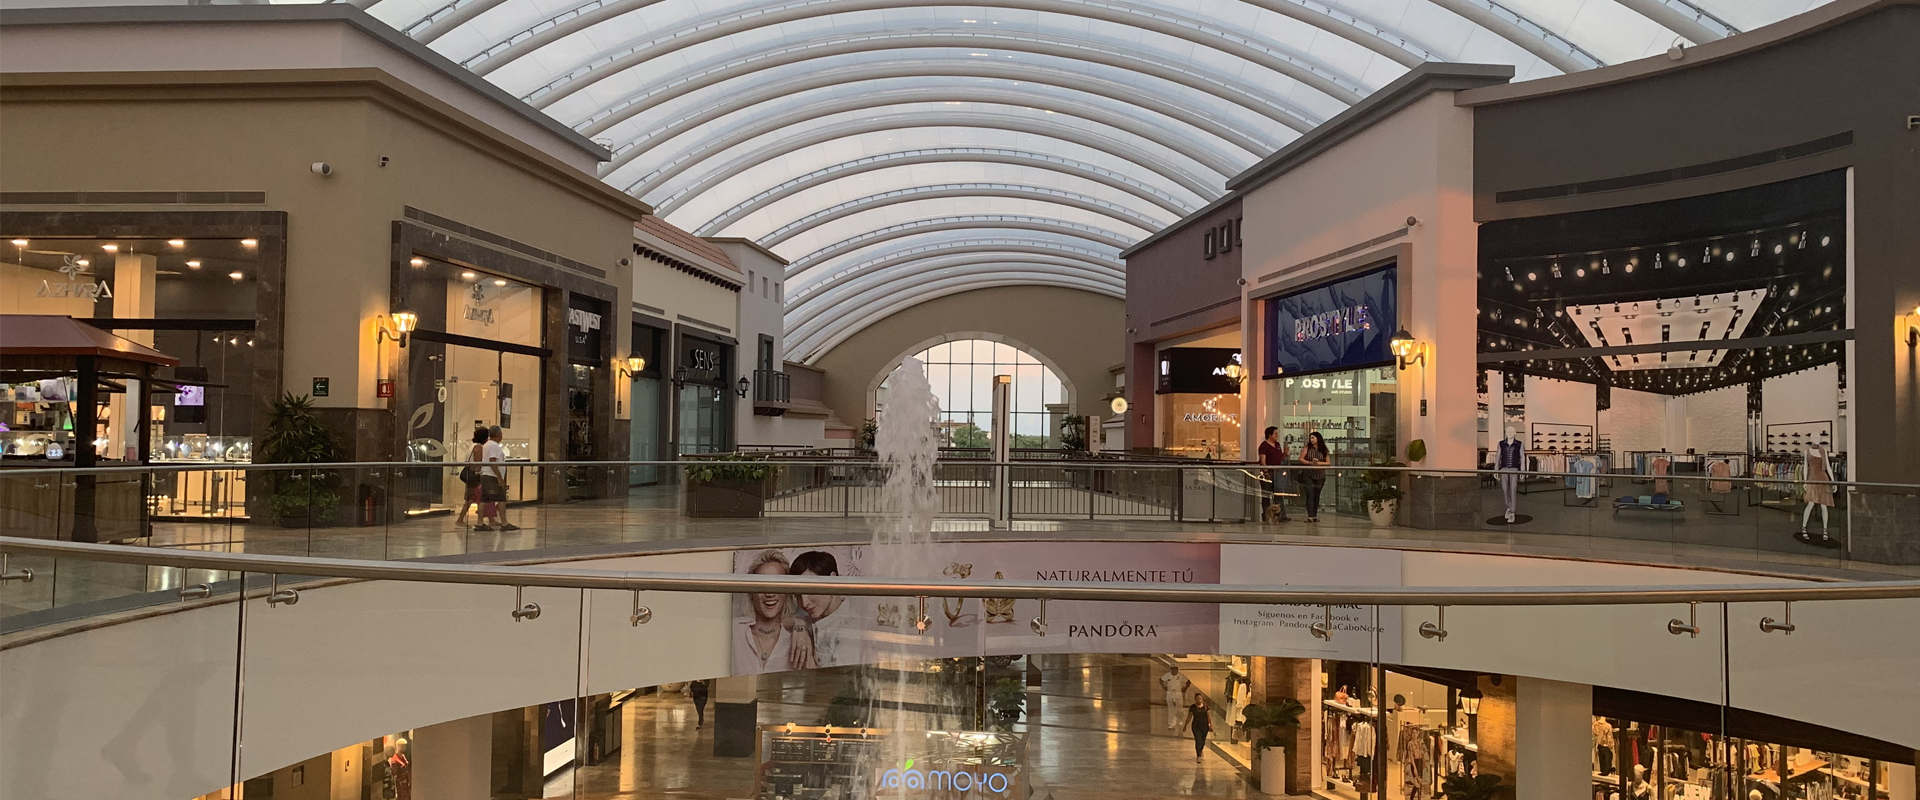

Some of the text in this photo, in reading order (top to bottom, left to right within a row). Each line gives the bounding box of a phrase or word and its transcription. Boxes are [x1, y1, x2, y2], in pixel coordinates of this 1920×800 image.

[568, 307, 602, 333] ASTWEST
[1294, 304, 1370, 342] PROSTYLE
[694, 349, 714, 371] SENS
[1036, 568, 1194, 583] NATURALMENTE TÚ
[1257, 610, 1295, 619] Síguenos
[1310, 612, 1351, 622] Facbook
